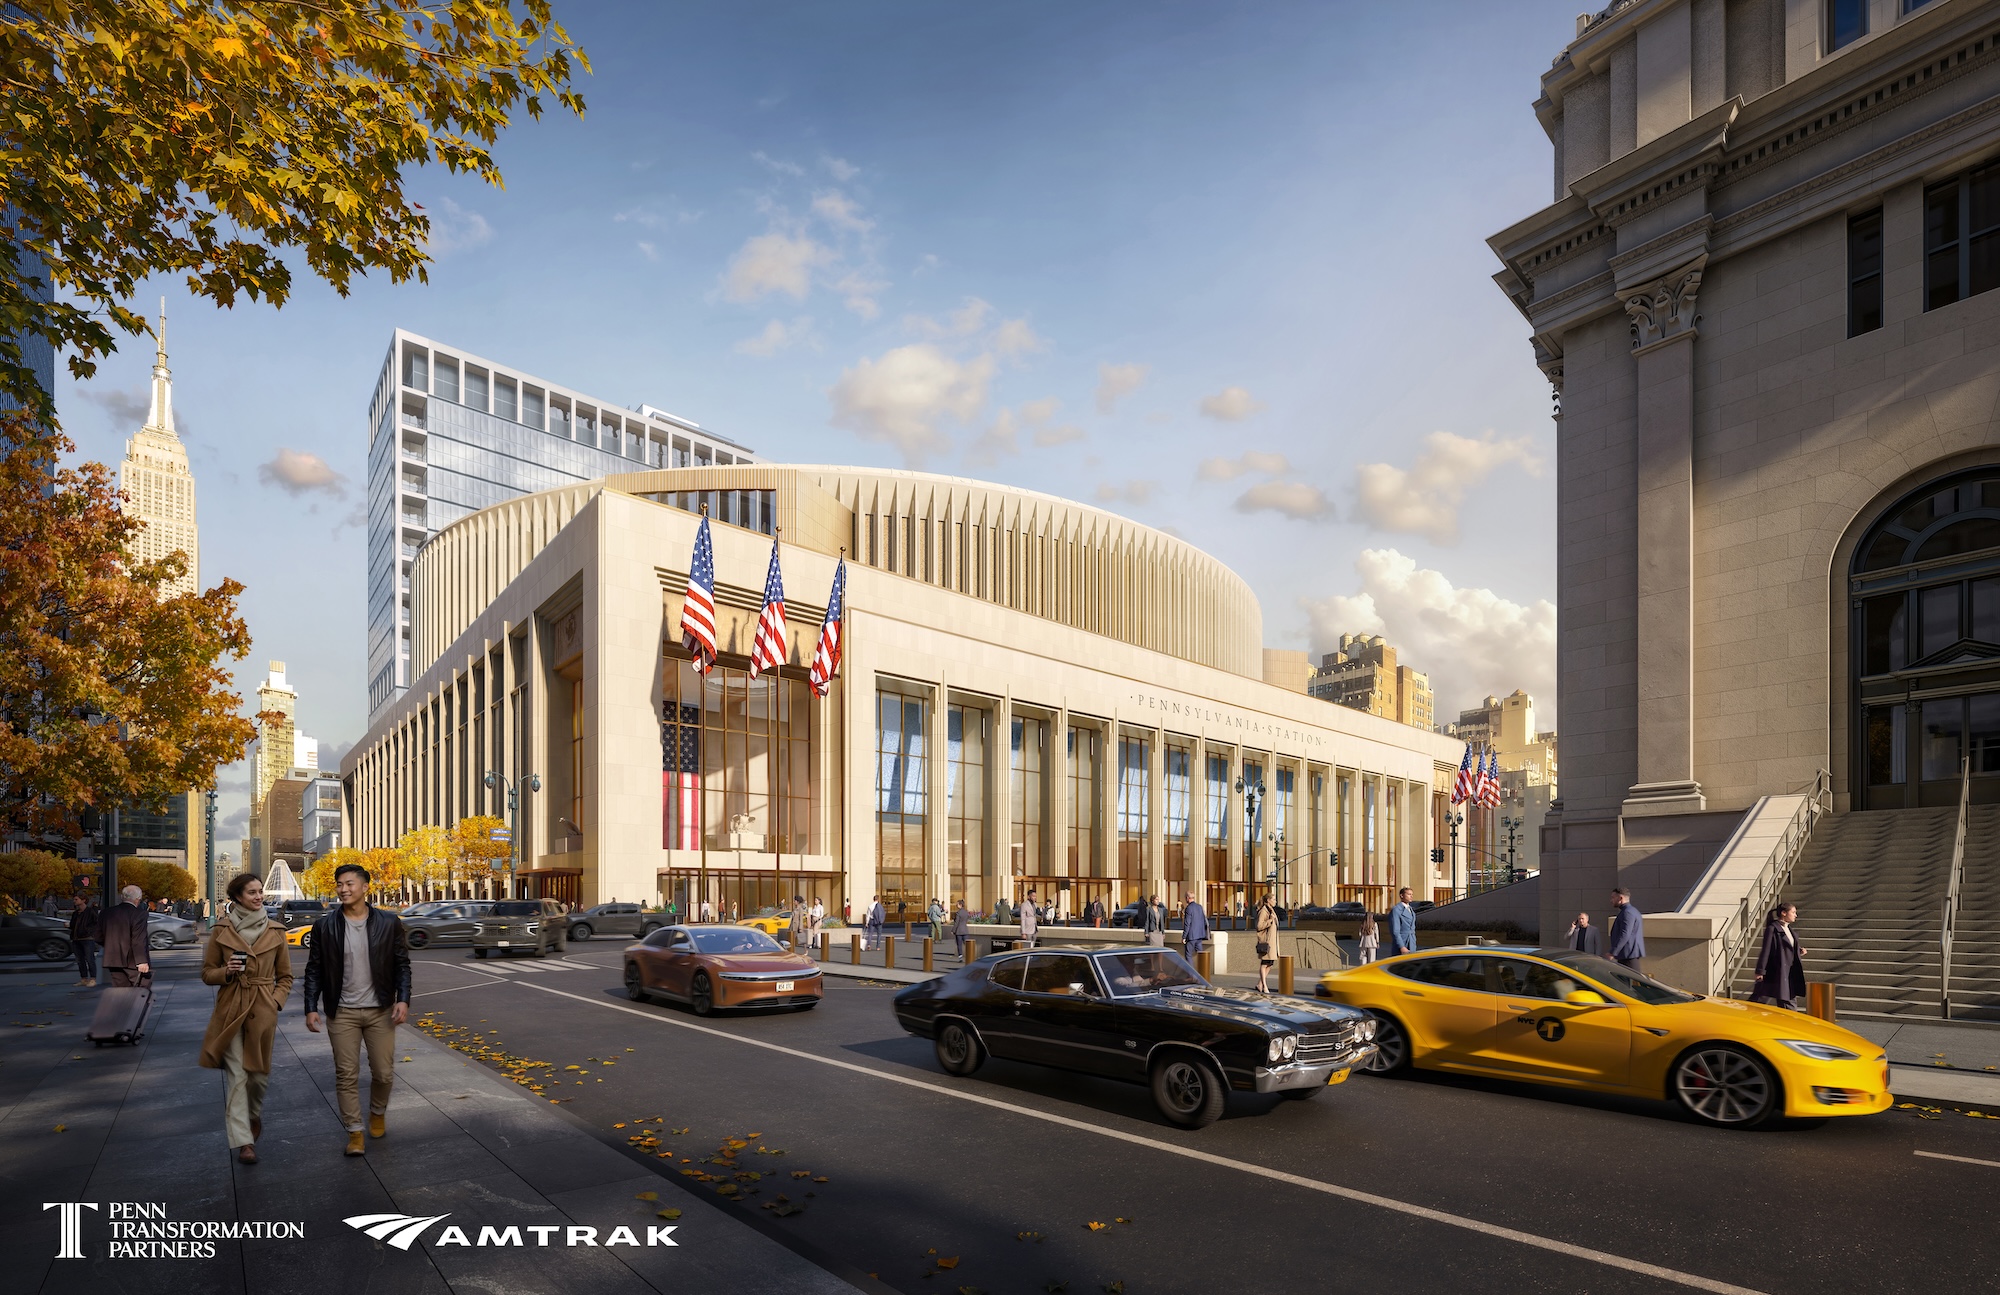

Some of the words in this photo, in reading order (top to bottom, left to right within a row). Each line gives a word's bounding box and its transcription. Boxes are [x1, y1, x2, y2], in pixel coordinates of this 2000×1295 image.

[1138, 694, 1259, 733] PENNSYLVANIA
[1268, 725, 1322, 746] STATION
[1517, 1017, 1535, 1025] NYC
